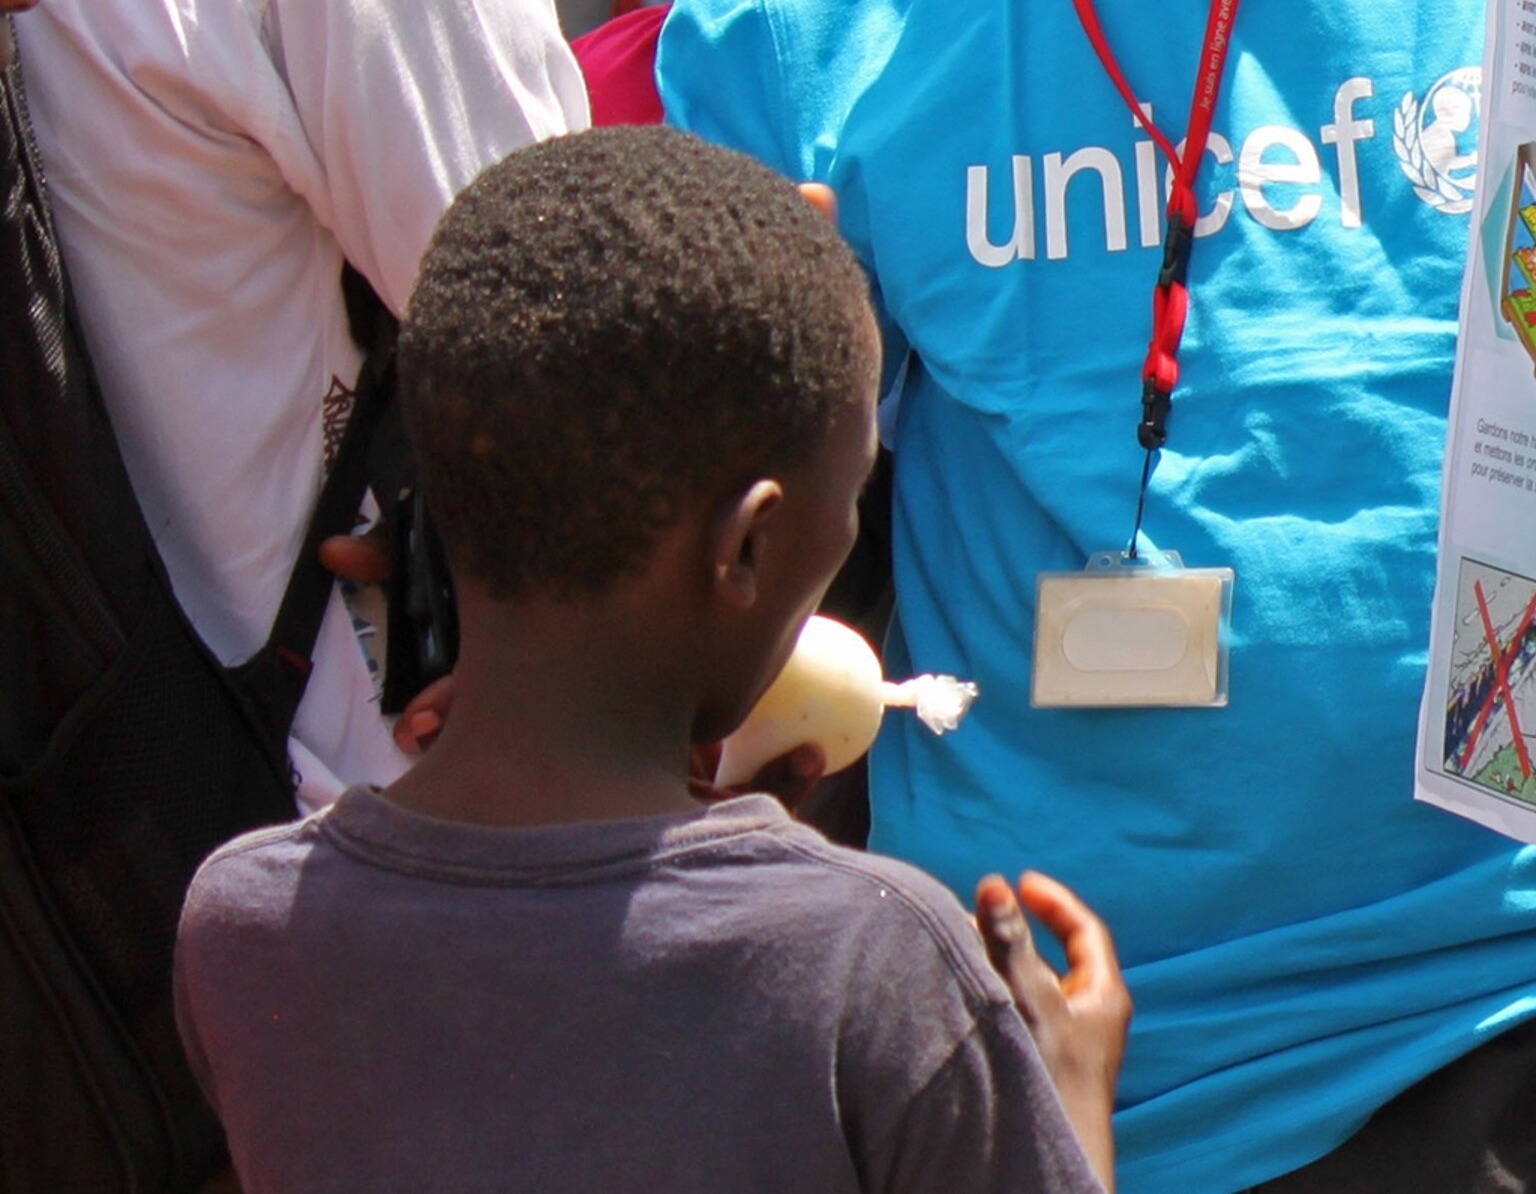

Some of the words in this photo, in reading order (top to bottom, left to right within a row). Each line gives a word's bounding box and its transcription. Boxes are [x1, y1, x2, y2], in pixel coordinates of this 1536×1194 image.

[1210, 20, 1228, 52] ligne
[1210, 53, 1221, 70] en
[1203, 71, 1217, 97] suis
[1200, 95, 1212, 113] Je
[964, 75, 1377, 269] unicef
[1477, 418, 1508, 441] Gardons
[1509, 430, 1530, 447] notre
[1474, 440, 1482, 454] et
[1483, 443, 1513, 464] mettons
[1514, 452, 1525, 467] les
[1471, 461, 1489, 477] pour
